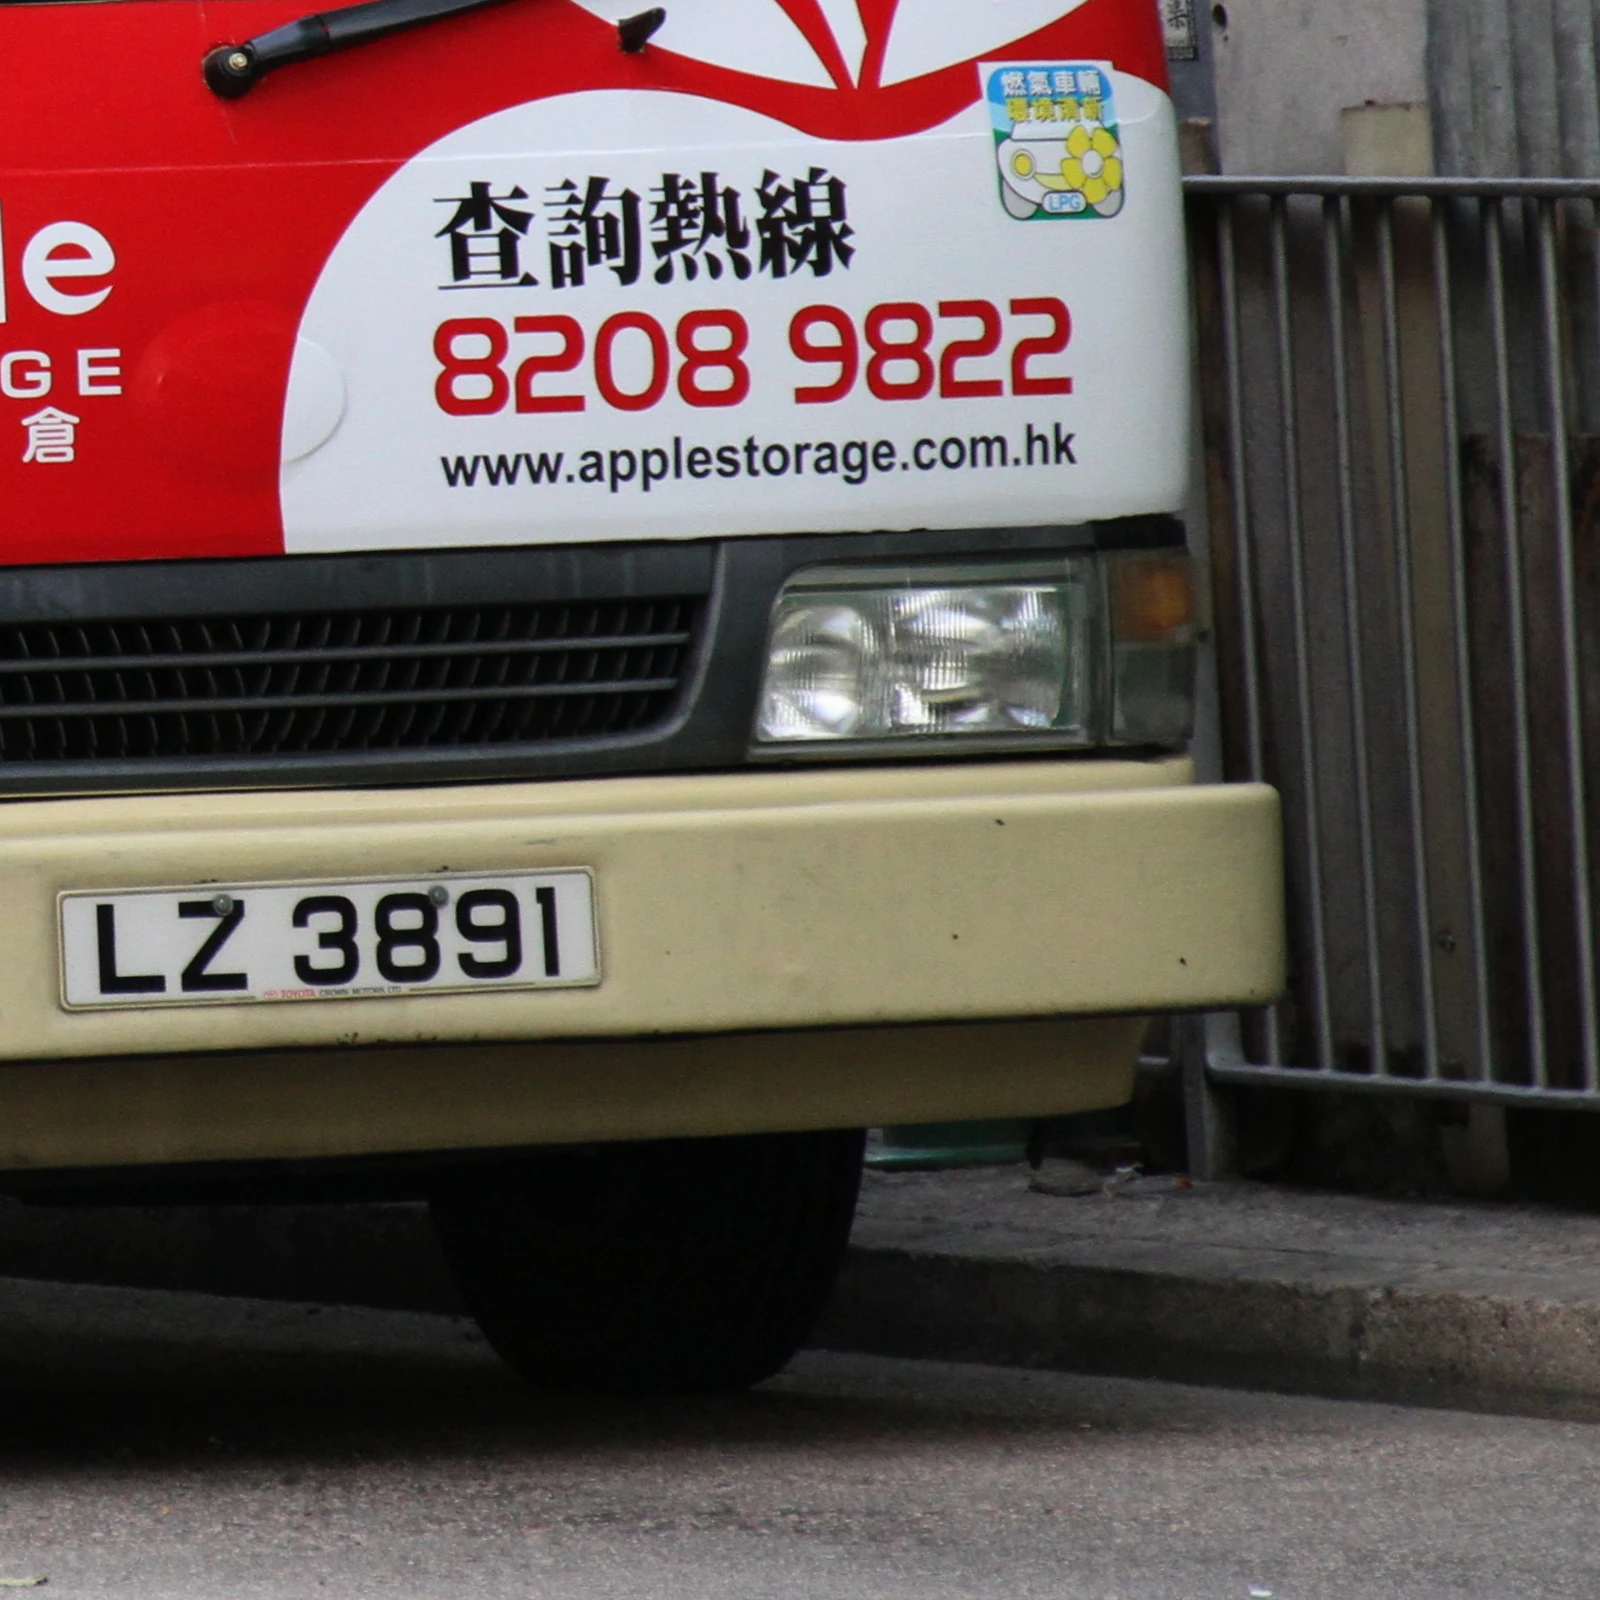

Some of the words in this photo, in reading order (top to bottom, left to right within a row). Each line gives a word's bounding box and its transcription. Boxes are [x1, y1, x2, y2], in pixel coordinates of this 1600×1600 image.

[432, 166, 857, 292] 查詢熱線
[1049, 194, 1082, 212] LPG
[432, 307, 751, 418] 8208
[788, 295, 1076, 407] 9822
[440, 423, 1079, 494] www.applestorage.com.hk
[95, 898, 249, 995] LZ
[291, 885, 562, 987] 3891
